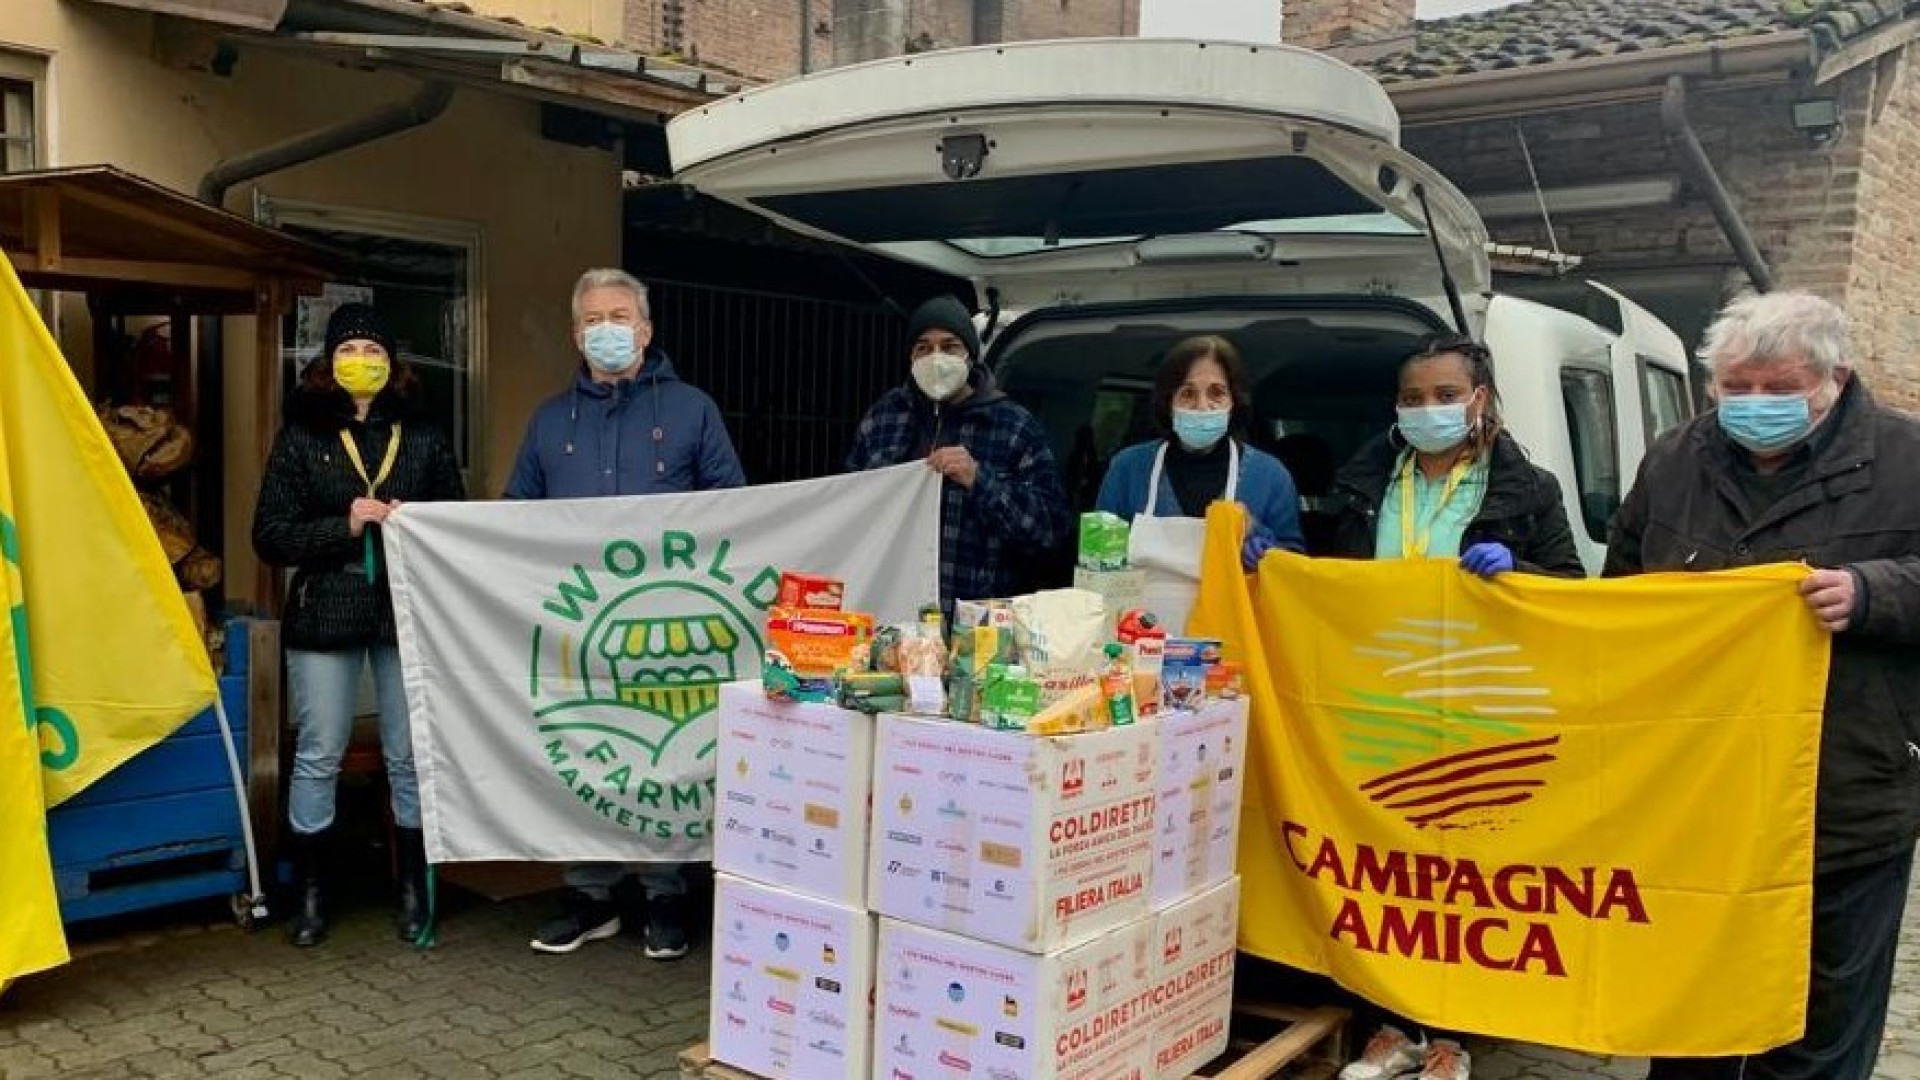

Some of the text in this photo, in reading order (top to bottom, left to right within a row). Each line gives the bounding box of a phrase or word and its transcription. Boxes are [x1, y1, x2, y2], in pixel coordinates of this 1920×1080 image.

[543, 529, 781, 622] WORLD
[546, 739, 672, 839] MARKETS
[585, 740, 715, 811] FARM
[1049, 795, 1155, 844] COLDIRETTI
[1056, 873, 1142, 919] FILIERA ITALIA
[1281, 821, 1650, 923] CAMPAGNA
[1330, 897, 1567, 977] AMICA
[1056, 989, 1153, 1056] COLDIRETTI
